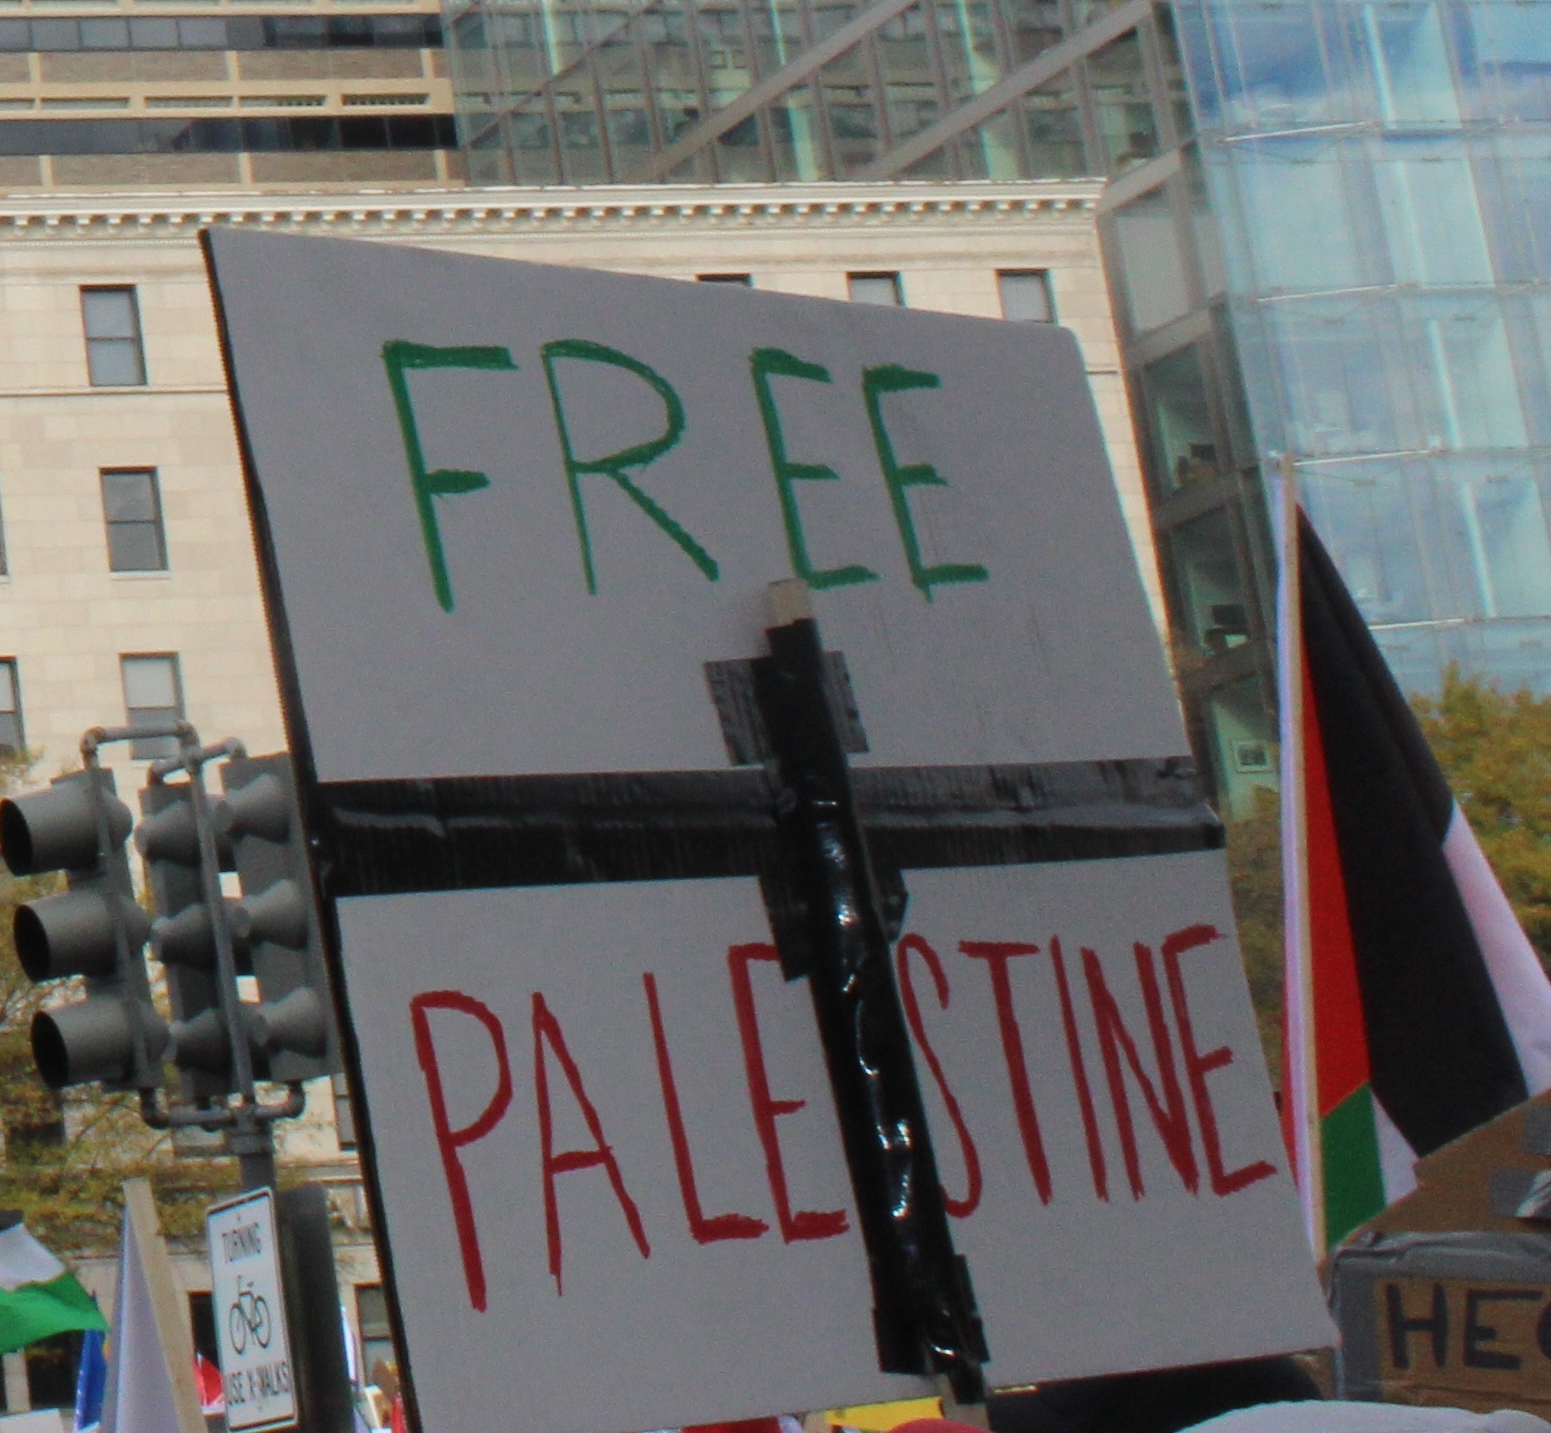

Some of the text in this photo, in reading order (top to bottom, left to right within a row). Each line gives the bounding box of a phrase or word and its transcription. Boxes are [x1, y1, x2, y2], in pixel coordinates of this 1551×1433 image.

[380, 337, 989, 613] FREE
[411, 923, 1277, 1314] PALESTINE
[1386, 1282, 1551, 1370] HE
